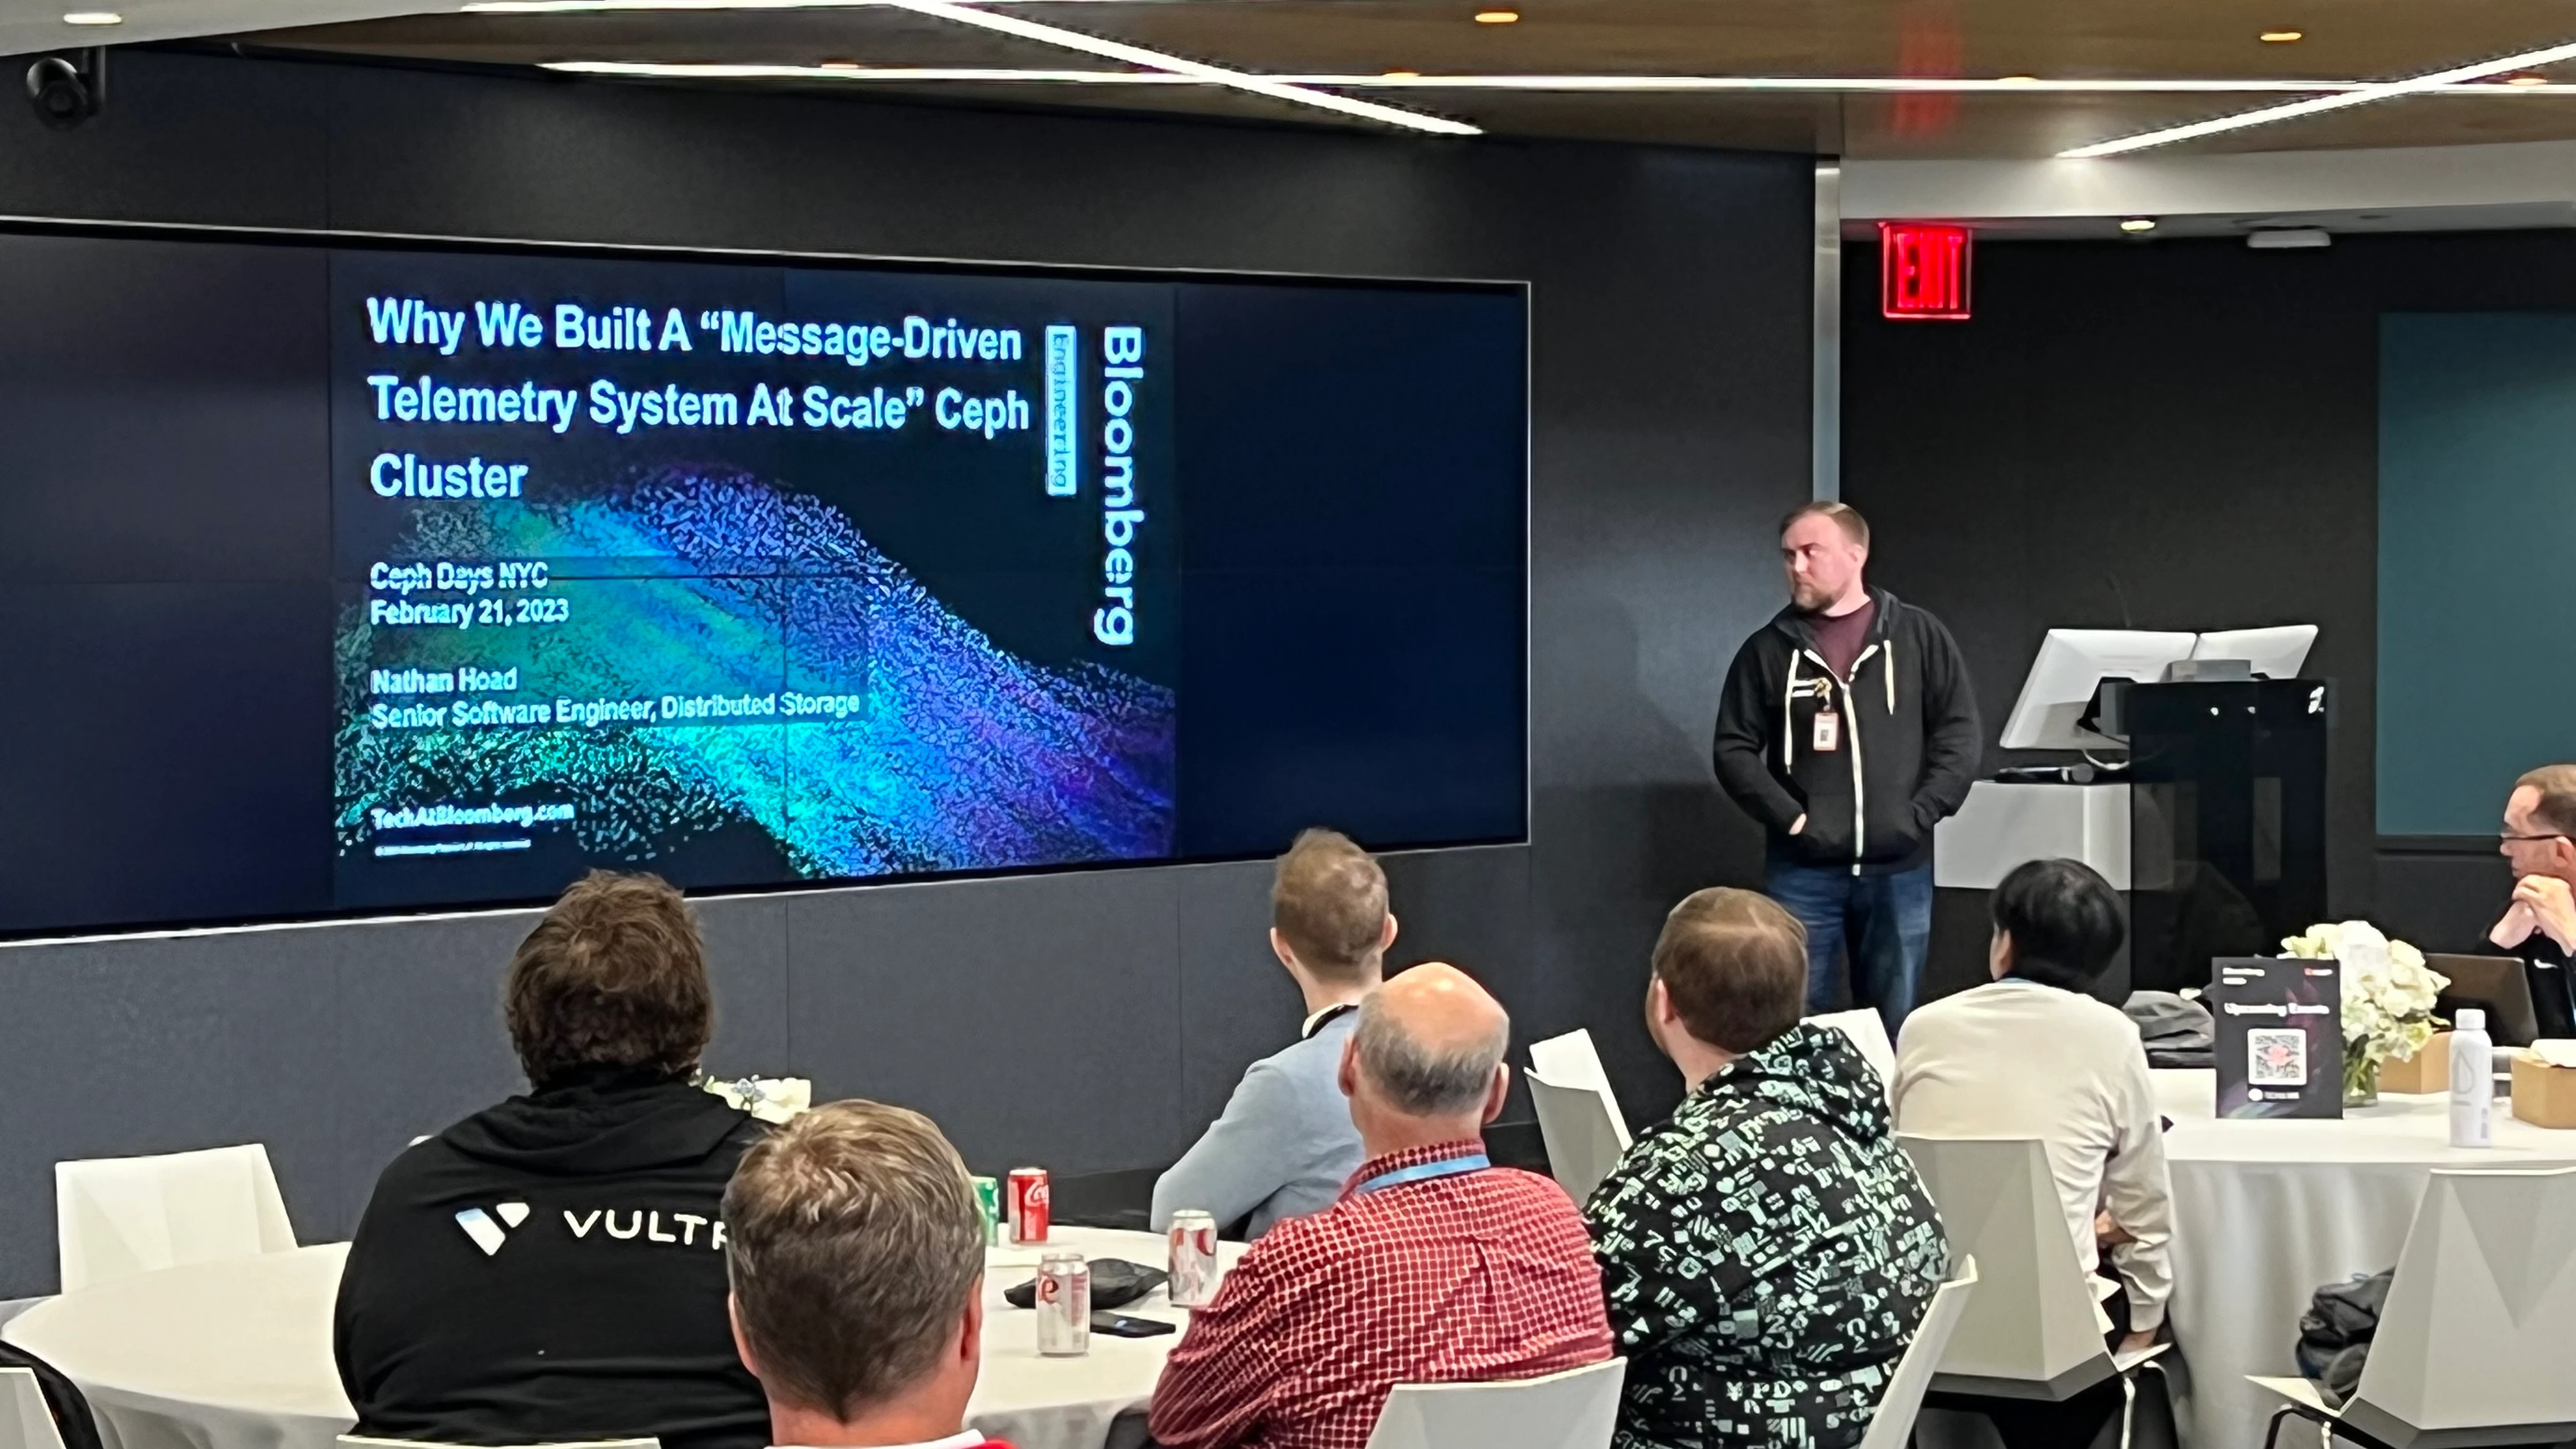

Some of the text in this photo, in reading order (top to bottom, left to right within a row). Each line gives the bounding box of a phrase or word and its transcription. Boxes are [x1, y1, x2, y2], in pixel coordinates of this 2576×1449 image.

[1897, 233, 1963, 309] EXIT
[367, 297, 1022, 366] Why We Built A “Message-Driven
[367, 375, 1029, 440] Telemetry System At Scale” Ceph
[1052, 334, 1071, 487] Engineering
[370, 453, 528, 498] Cluster
[1094, 326, 1145, 646] Bloomberg
[370, 562, 548, 595] Ceph Days NYC
[371, 598, 569, 630] February 21, 2023
[371, 666, 518, 694] Nathan Hoad
[372, 691, 860, 729] Senior Software Engineer, Distributed Storage
[370, 802, 575, 831] TechAtBloomberg.com
